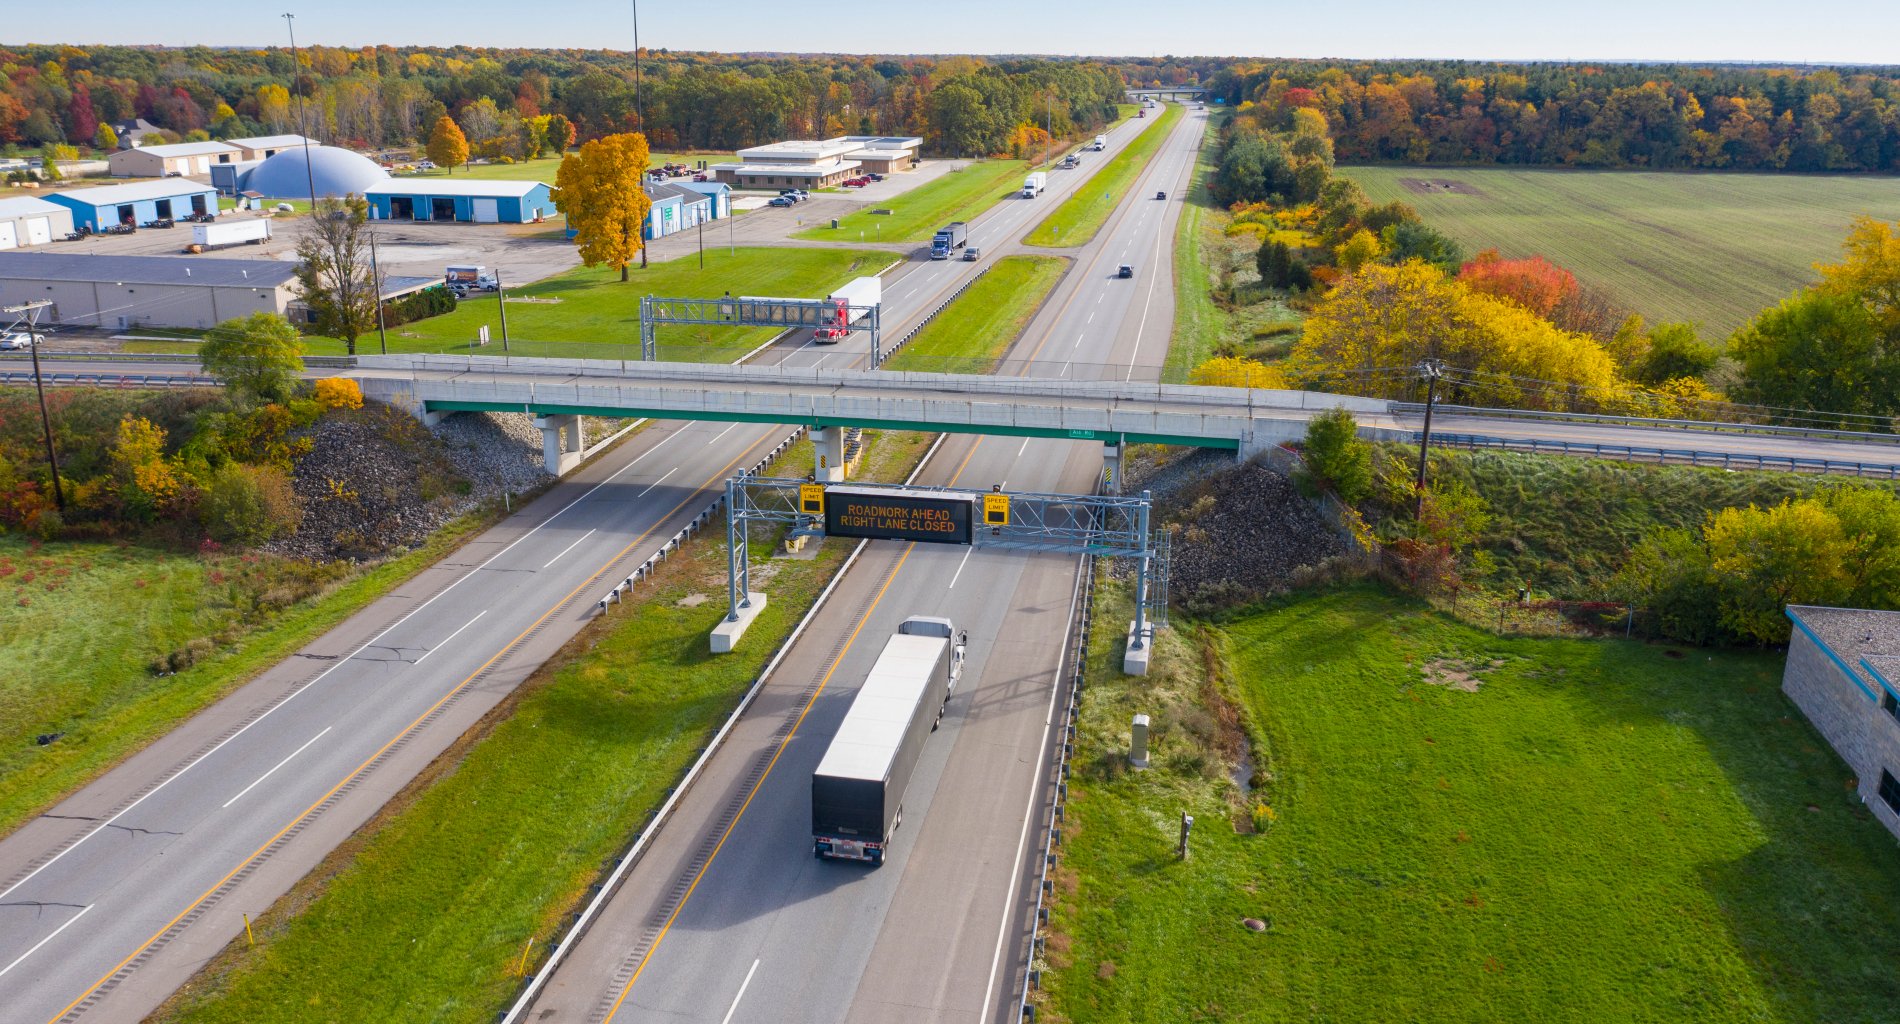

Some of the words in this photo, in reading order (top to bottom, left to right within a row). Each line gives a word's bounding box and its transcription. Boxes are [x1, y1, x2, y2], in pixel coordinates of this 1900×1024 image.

[848, 504, 909, 519] ROADWORK
[911, 508, 950, 521] AHEAD
[840, 515, 876, 528] RIGHT
[877, 517, 908, 530] LANE
[910, 519, 955, 532] CLOSED
